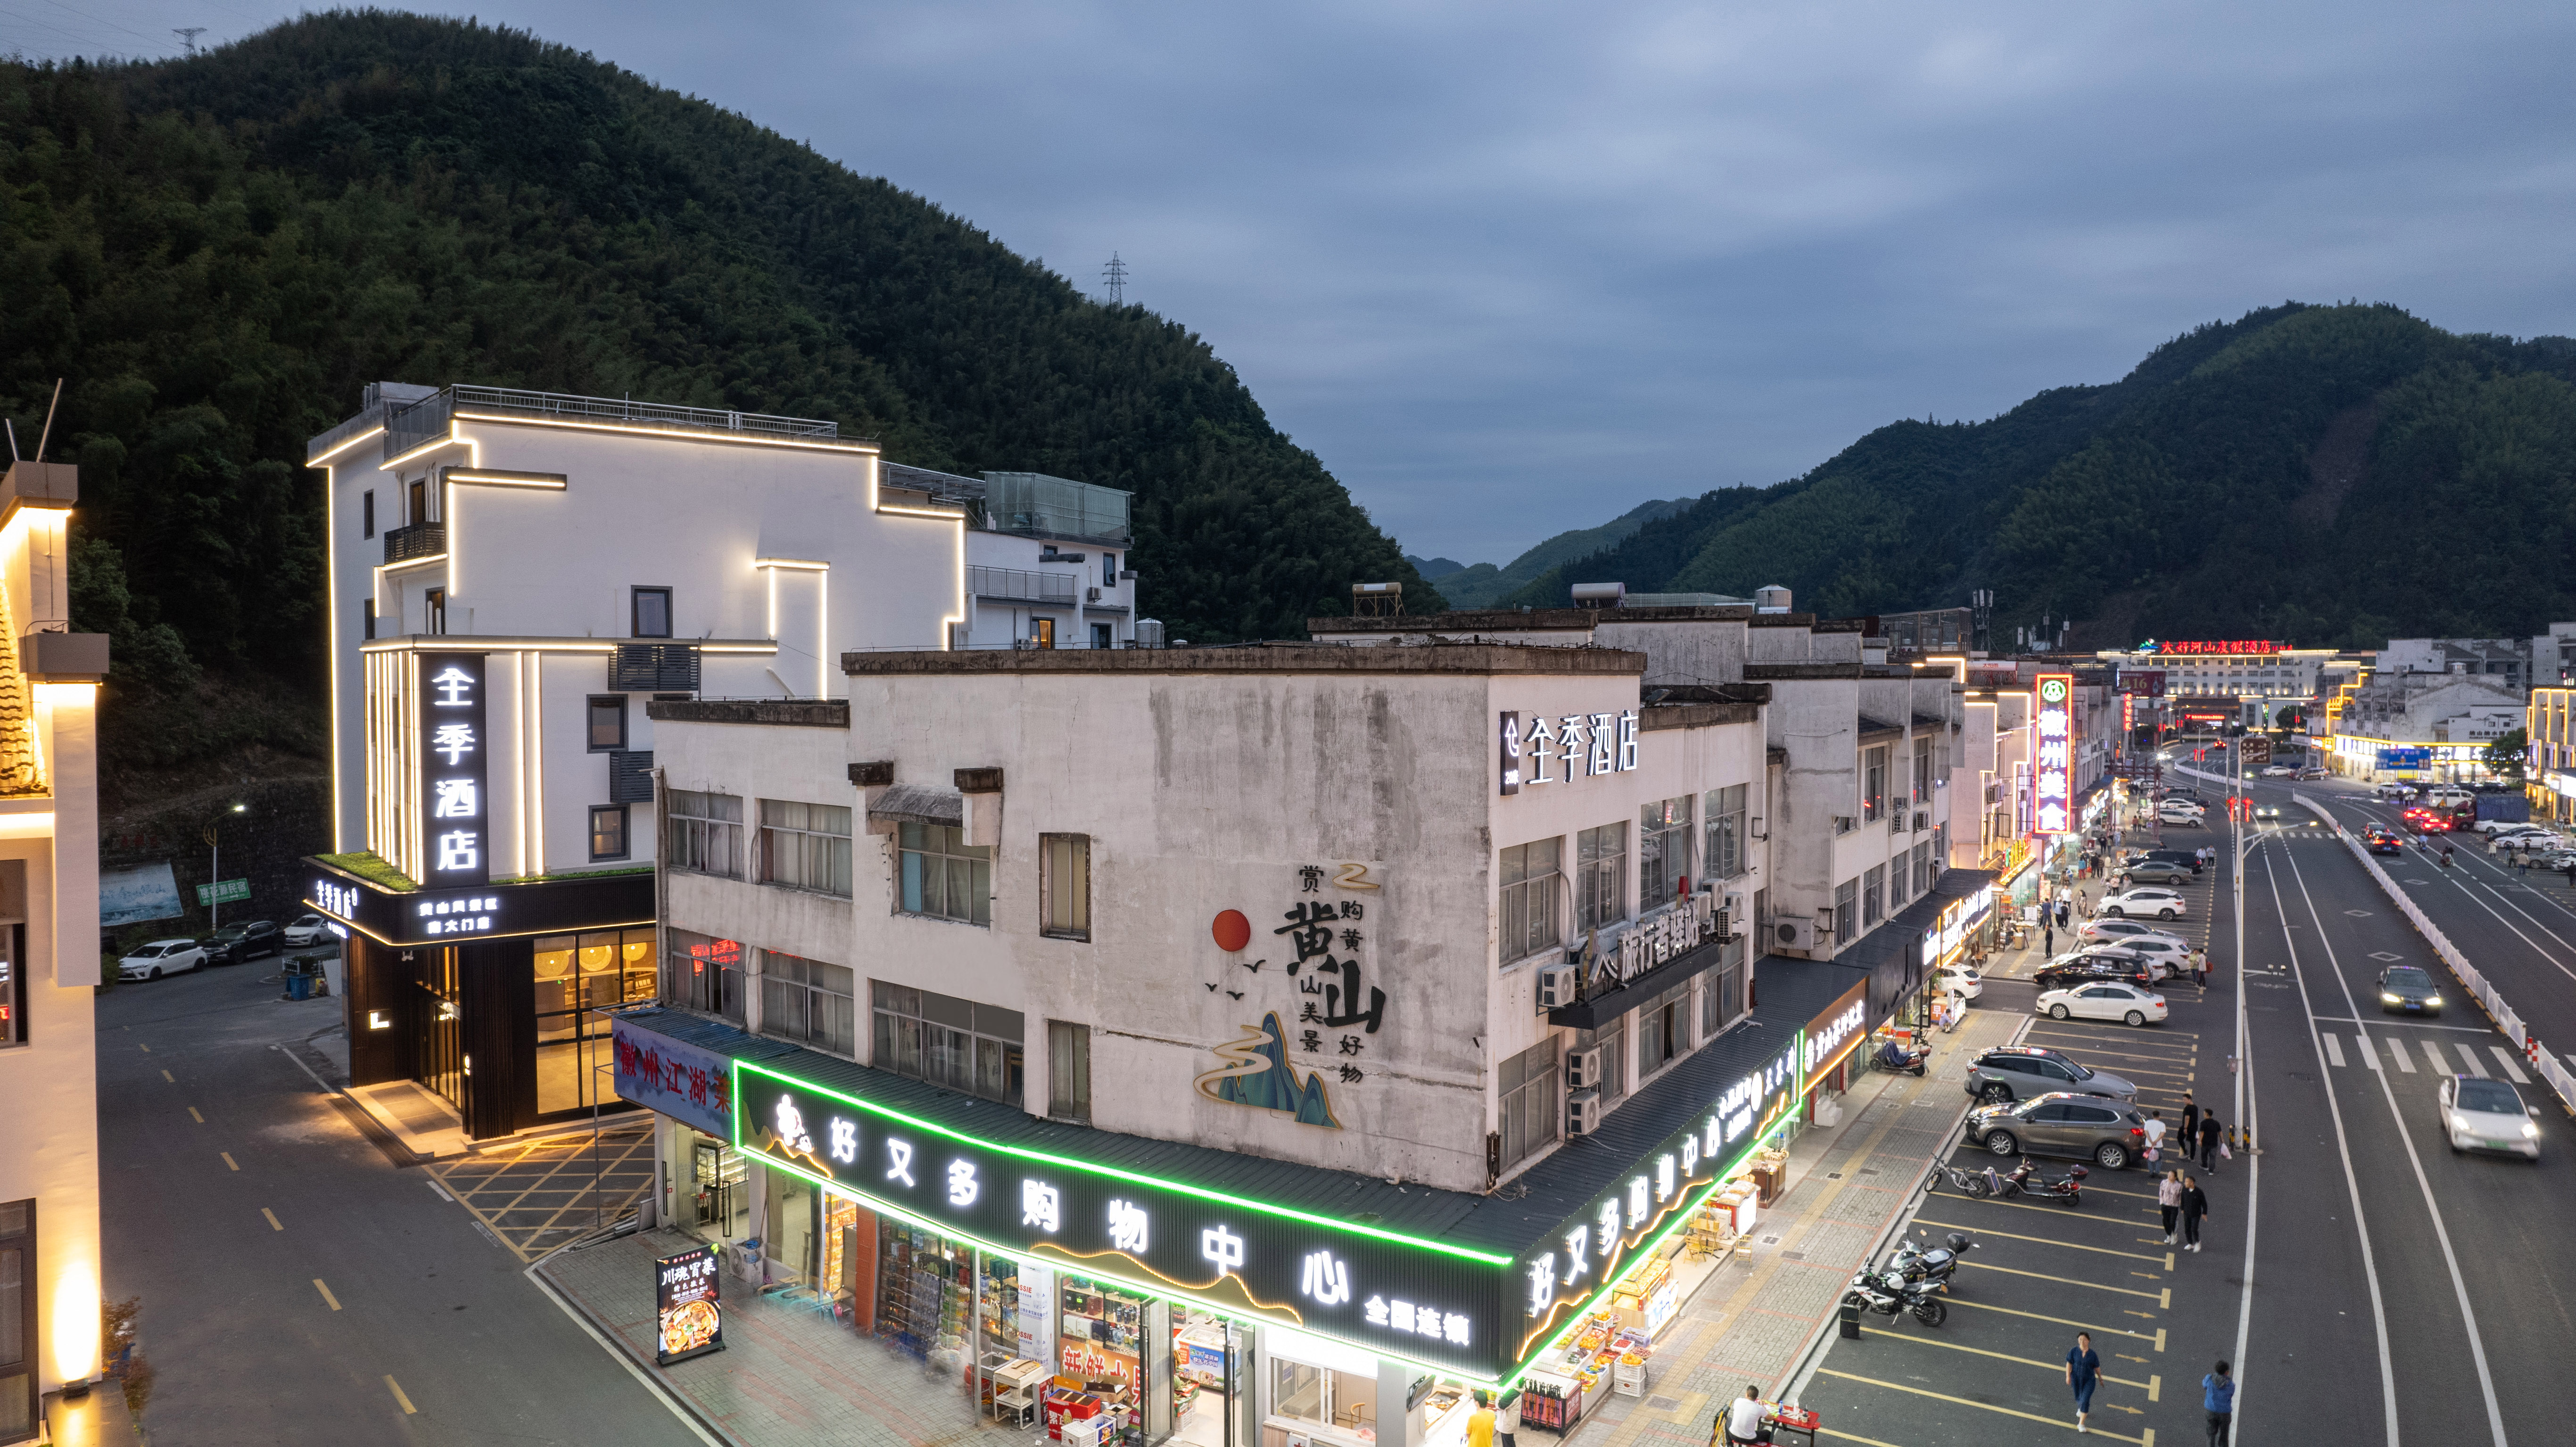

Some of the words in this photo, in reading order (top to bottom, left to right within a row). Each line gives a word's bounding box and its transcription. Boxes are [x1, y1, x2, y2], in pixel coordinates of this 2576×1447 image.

[2161, 640, 2271, 655] 大好河山度假酒店
[432, 668, 476, 871] 全季酒店
[1523, 710, 1639, 785] 全季酒店
[2038, 709, 2068, 831] 徽州美食
[199, 881, 247, 899] 桃花源民宿
[316, 880, 352, 920] 全季酒店
[1299, 865, 1324, 892] 赏
[1274, 901, 1386, 1034] 黄山
[1621, 903, 1699, 982] 旅行者驿站
[620, 1040, 732, 1114] 徽州江湖菜
[831, 1117, 1350, 1304] 好又多购物中心
[1527, 1115, 1721, 1318] 好又多购物中心
[1364, 1295, 1470, 1346] 全国连锁
